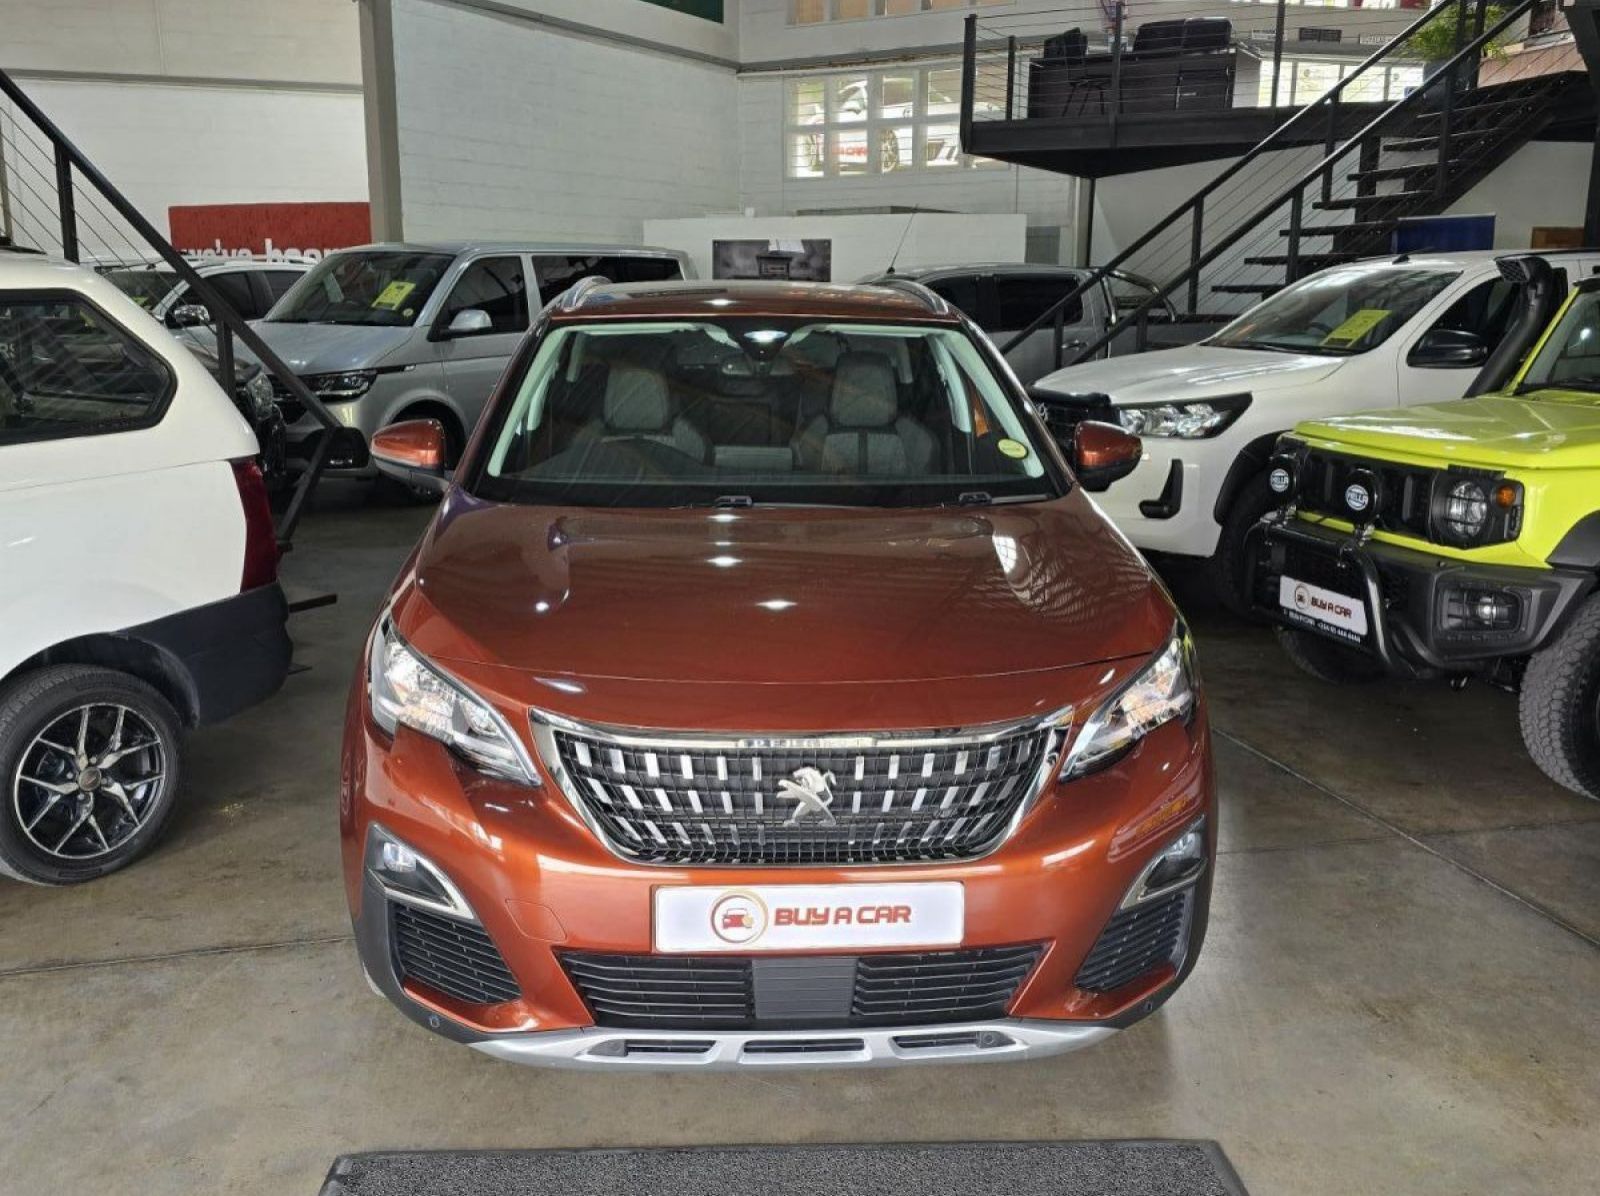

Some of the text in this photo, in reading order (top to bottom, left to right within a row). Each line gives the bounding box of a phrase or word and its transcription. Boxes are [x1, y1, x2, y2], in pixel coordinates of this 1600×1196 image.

[1311, 597, 1352, 619] BUY A CAR
[774, 905, 912, 926] BUY A CAR
